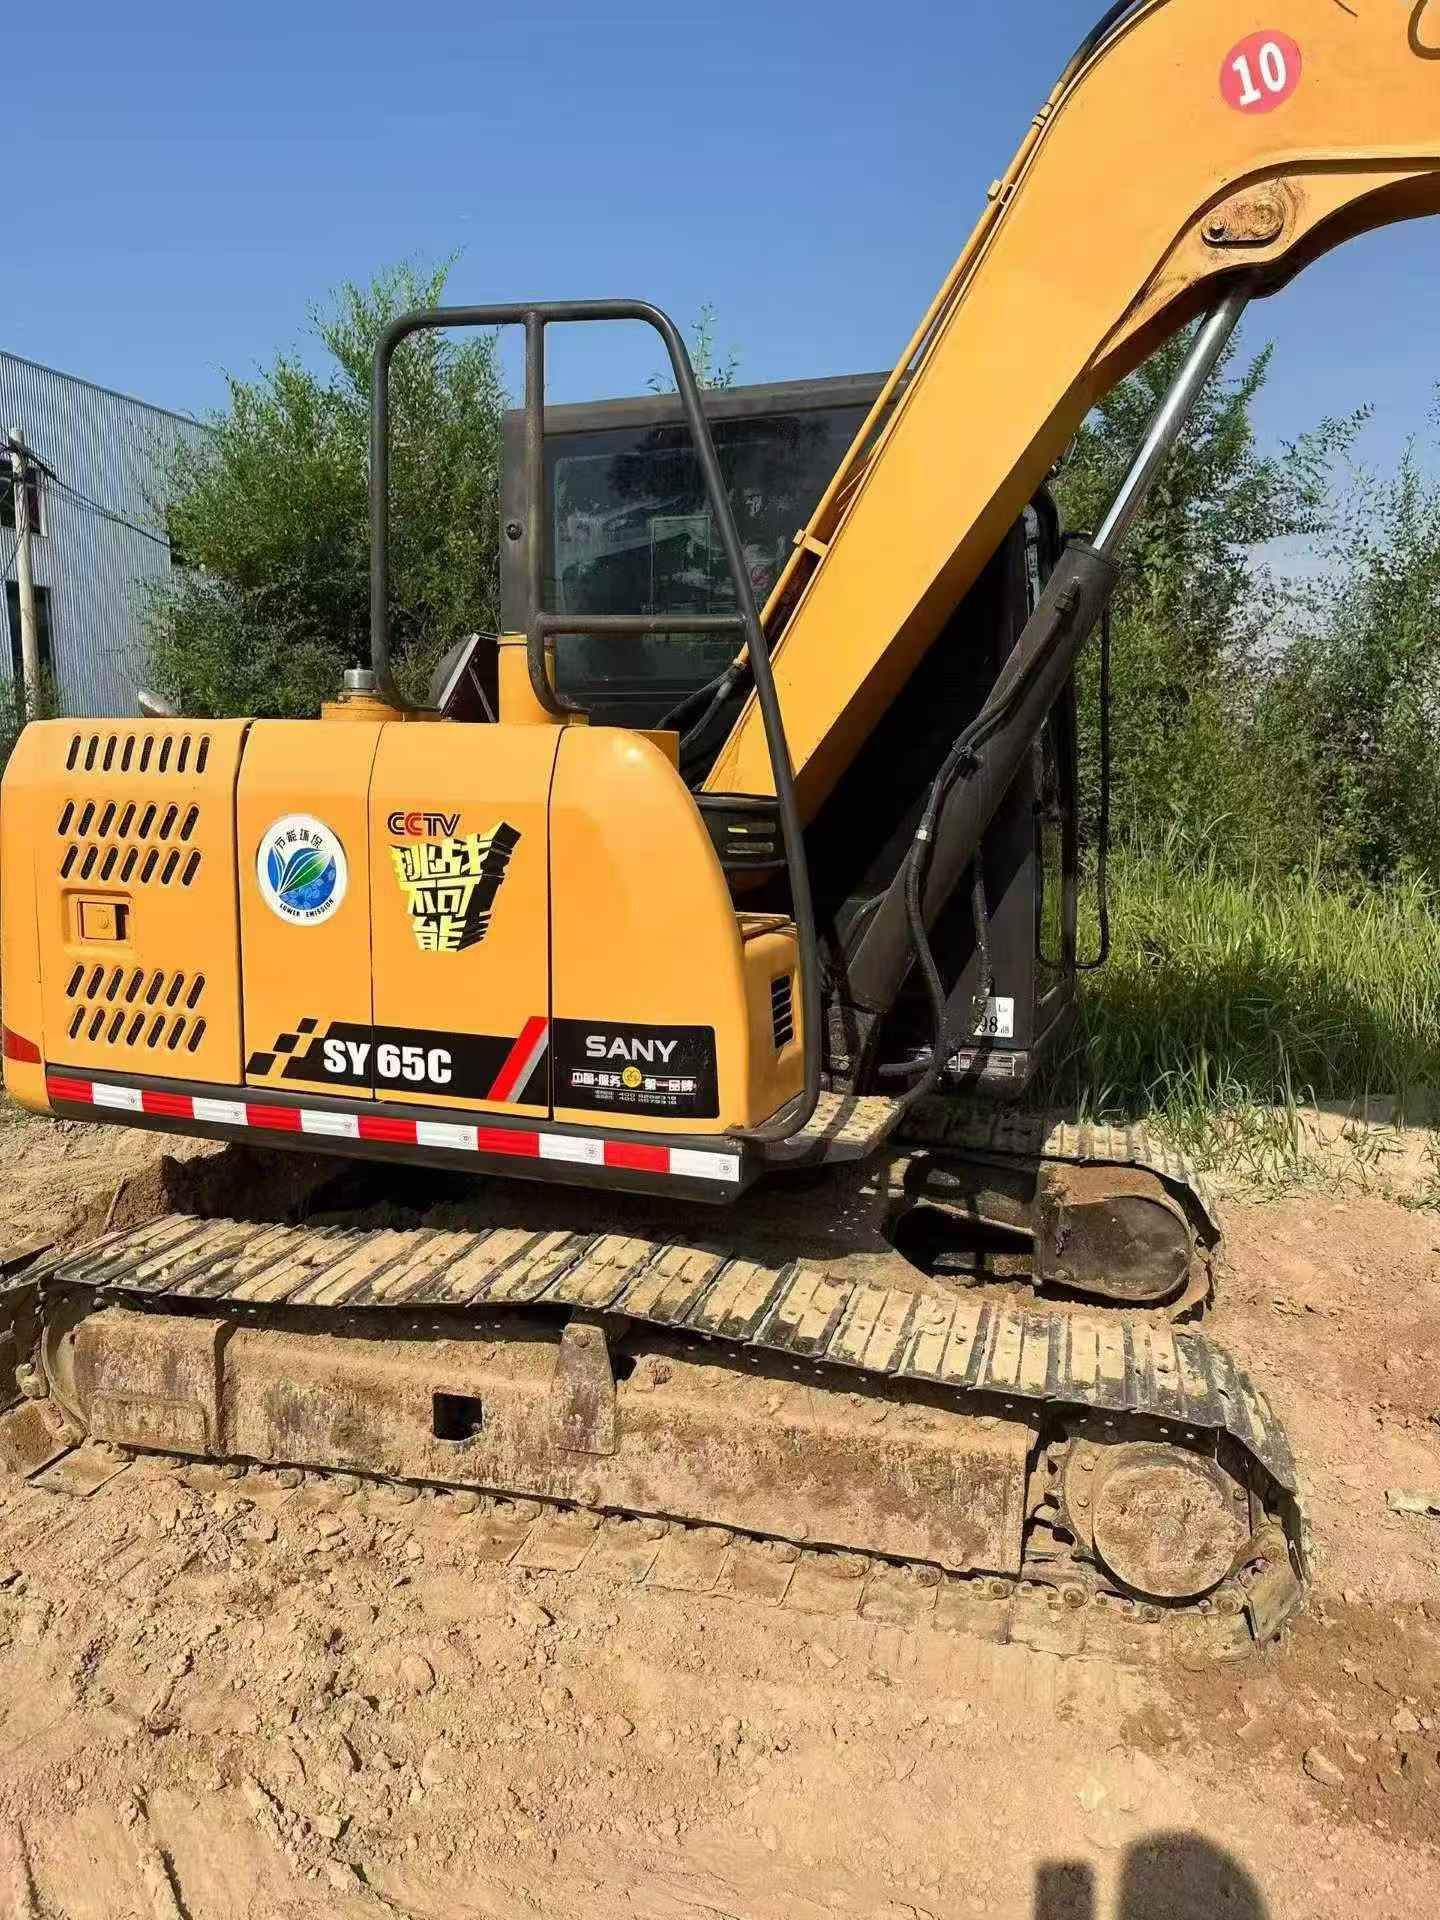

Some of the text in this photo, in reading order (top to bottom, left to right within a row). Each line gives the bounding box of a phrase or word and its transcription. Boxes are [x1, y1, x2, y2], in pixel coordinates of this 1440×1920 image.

[1231, 41, 1287, 106] 10
[387, 811, 461, 837] CCTV
[279, 897, 335, 918] LOWER EMISSION
[585, 1034, 678, 1063] SANY
